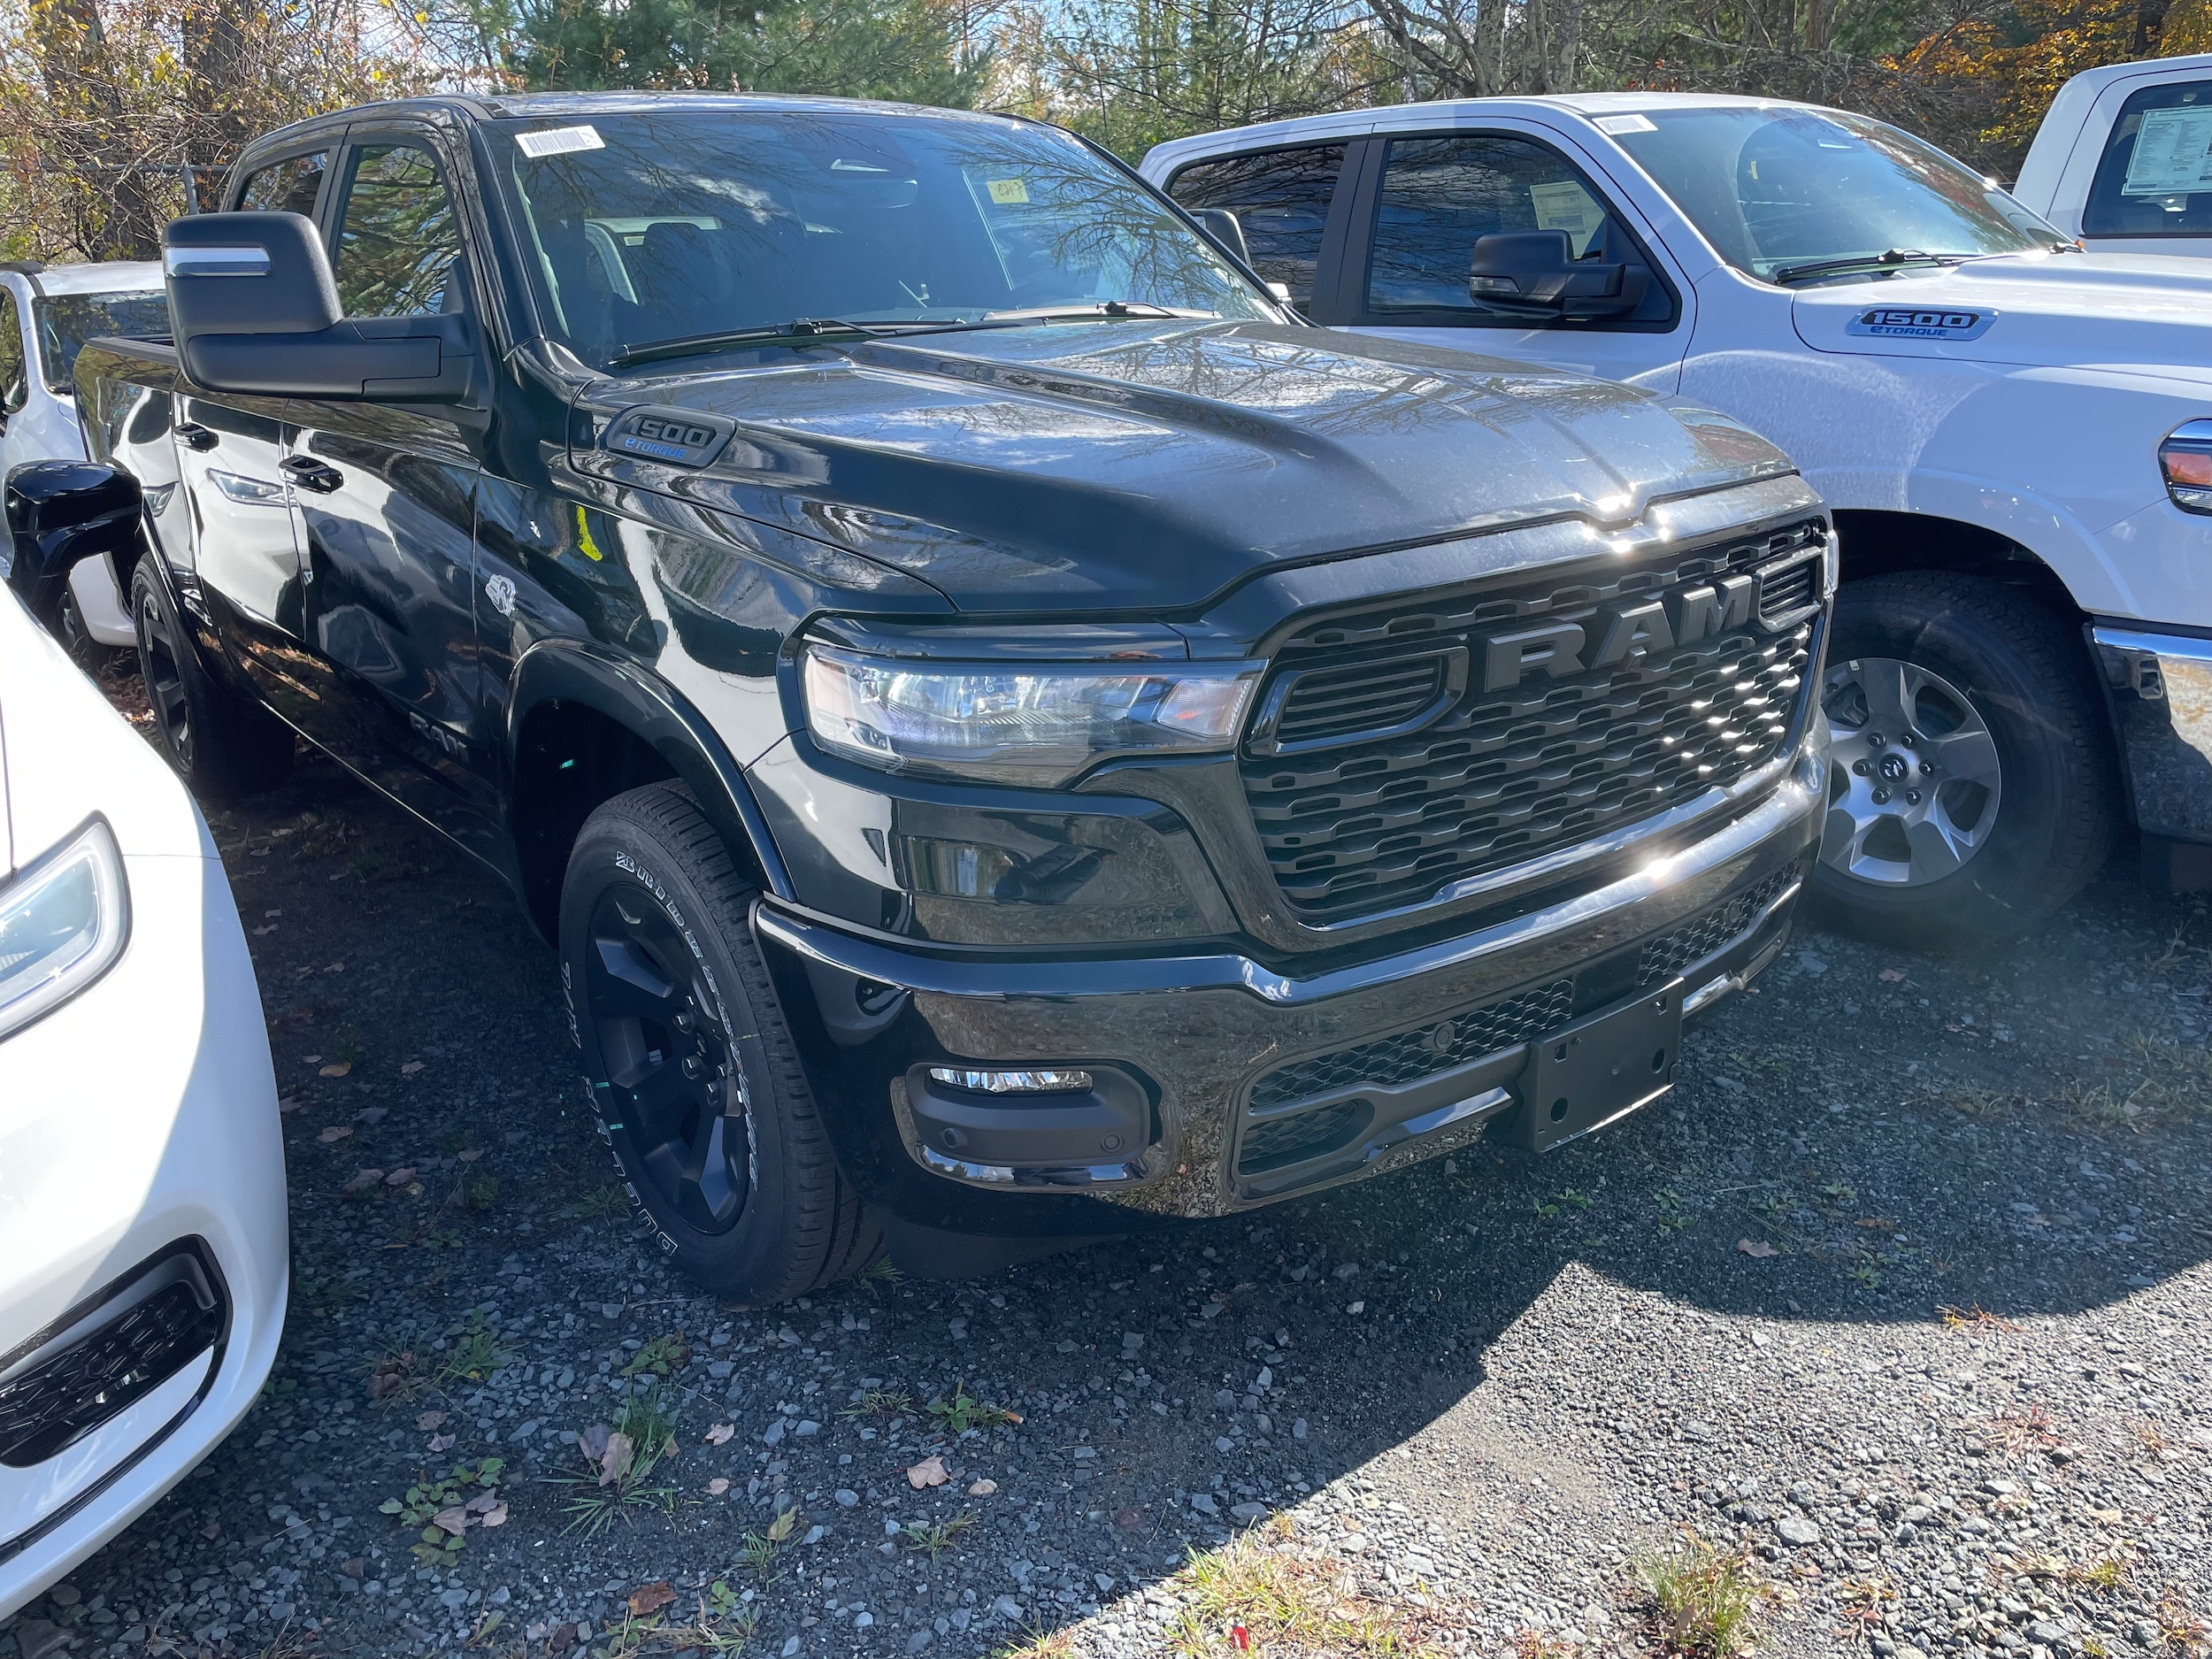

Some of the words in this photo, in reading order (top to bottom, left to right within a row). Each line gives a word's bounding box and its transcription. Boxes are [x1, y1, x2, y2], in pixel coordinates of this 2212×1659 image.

[1873, 311, 1972, 327] 1500
[628, 417, 712, 448] 1500
[1484, 574, 1753, 694] RAM
[409, 710, 471, 766] RAM
[615, 849, 760, 1193] BRIDGESTONE
